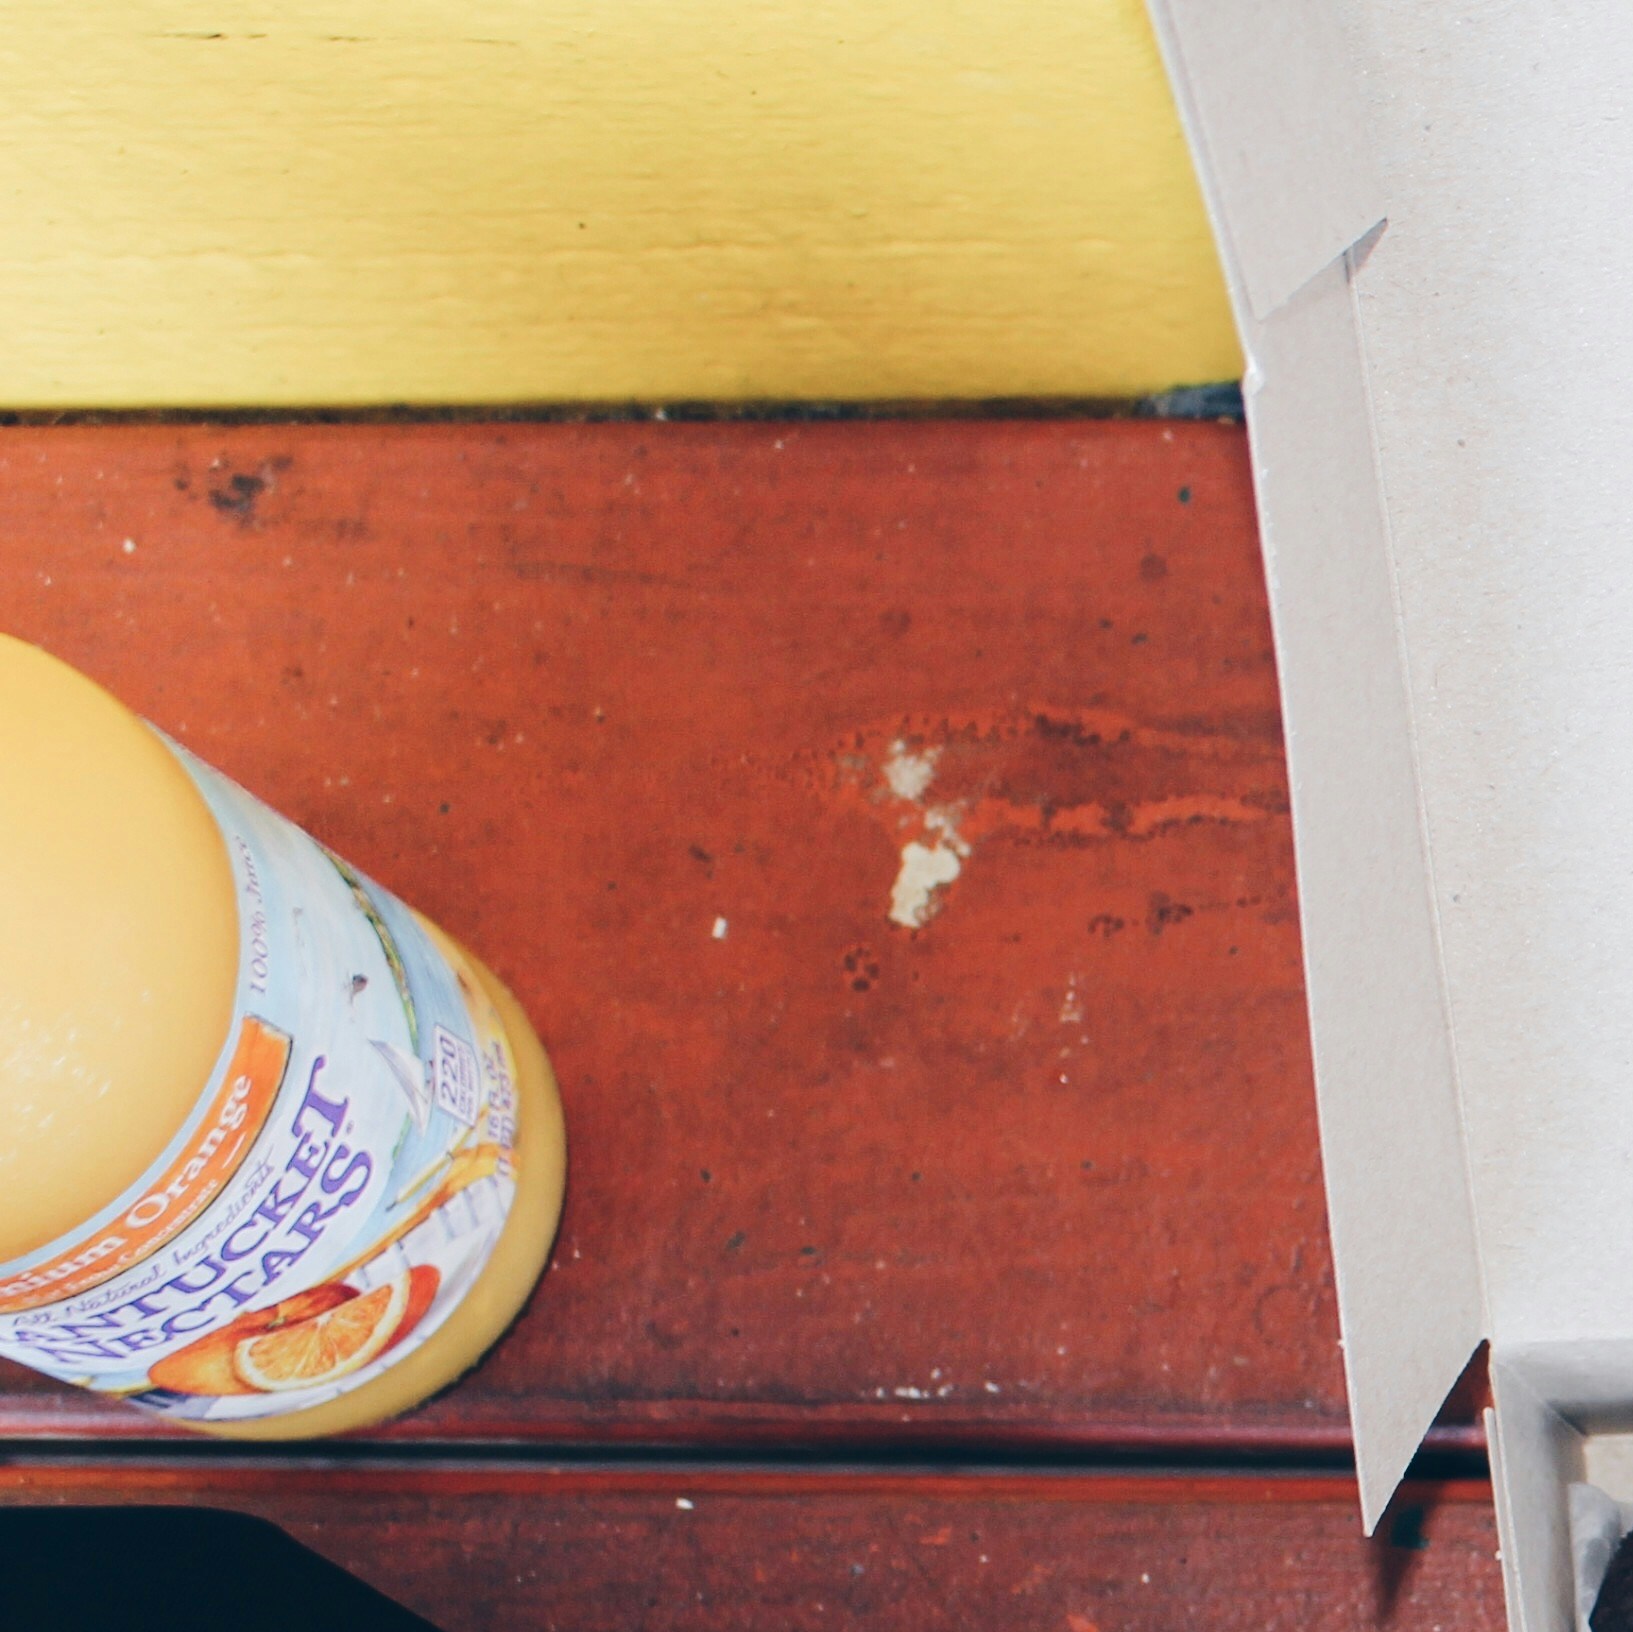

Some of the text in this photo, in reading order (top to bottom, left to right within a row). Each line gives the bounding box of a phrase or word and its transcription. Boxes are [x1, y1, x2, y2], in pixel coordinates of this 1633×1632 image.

[250, 910, 269, 997] 100%
[439, 1034, 458, 1105] 220
[0, 1054, 350, 1344] ANTUCKET
[65, 1265, 167, 1318] Natural
[172, 1145, 276, 1267] Ingredients
[125, 1074, 252, 1230] Orange
[36, 1144, 373, 1364] NECTARS
